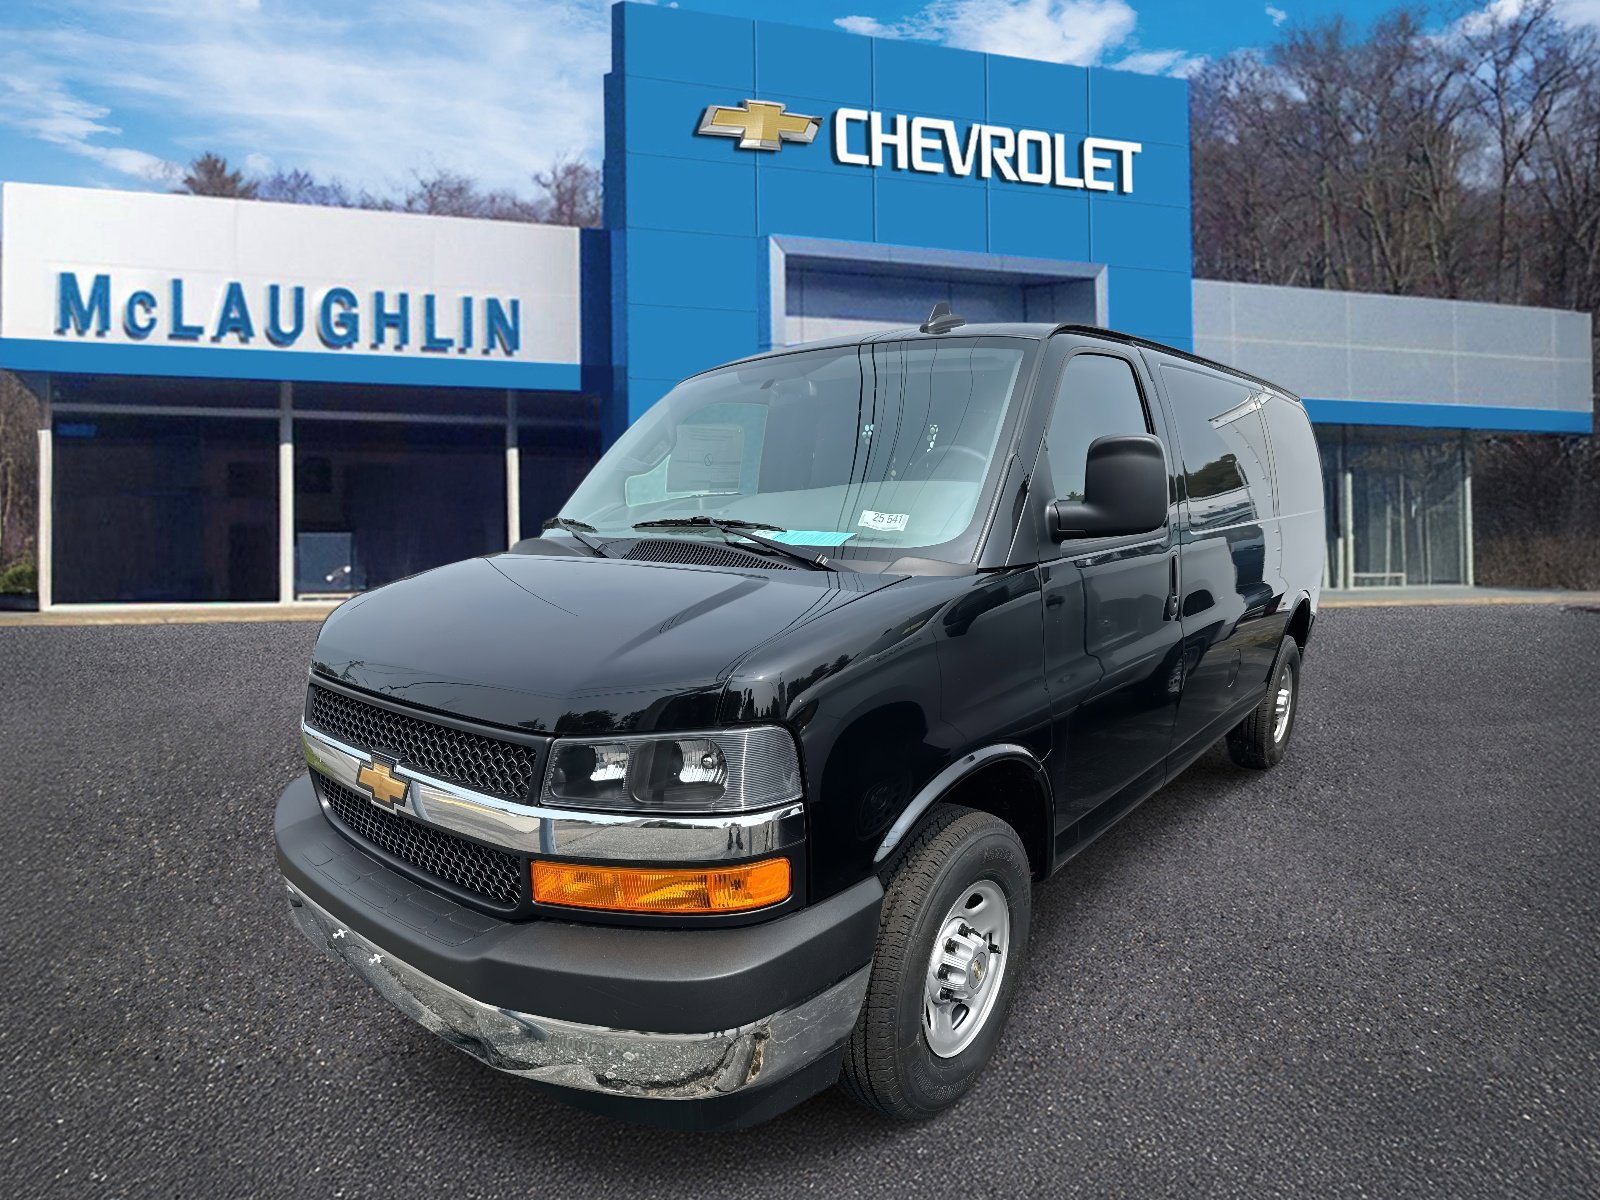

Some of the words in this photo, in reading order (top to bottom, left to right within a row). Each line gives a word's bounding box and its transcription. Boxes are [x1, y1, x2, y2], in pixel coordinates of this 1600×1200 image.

[834, 107, 1142, 193] CHEVROLET
[55, 271, 520, 355] McLAUGHLIN
[872, 512, 885, 523] 25
